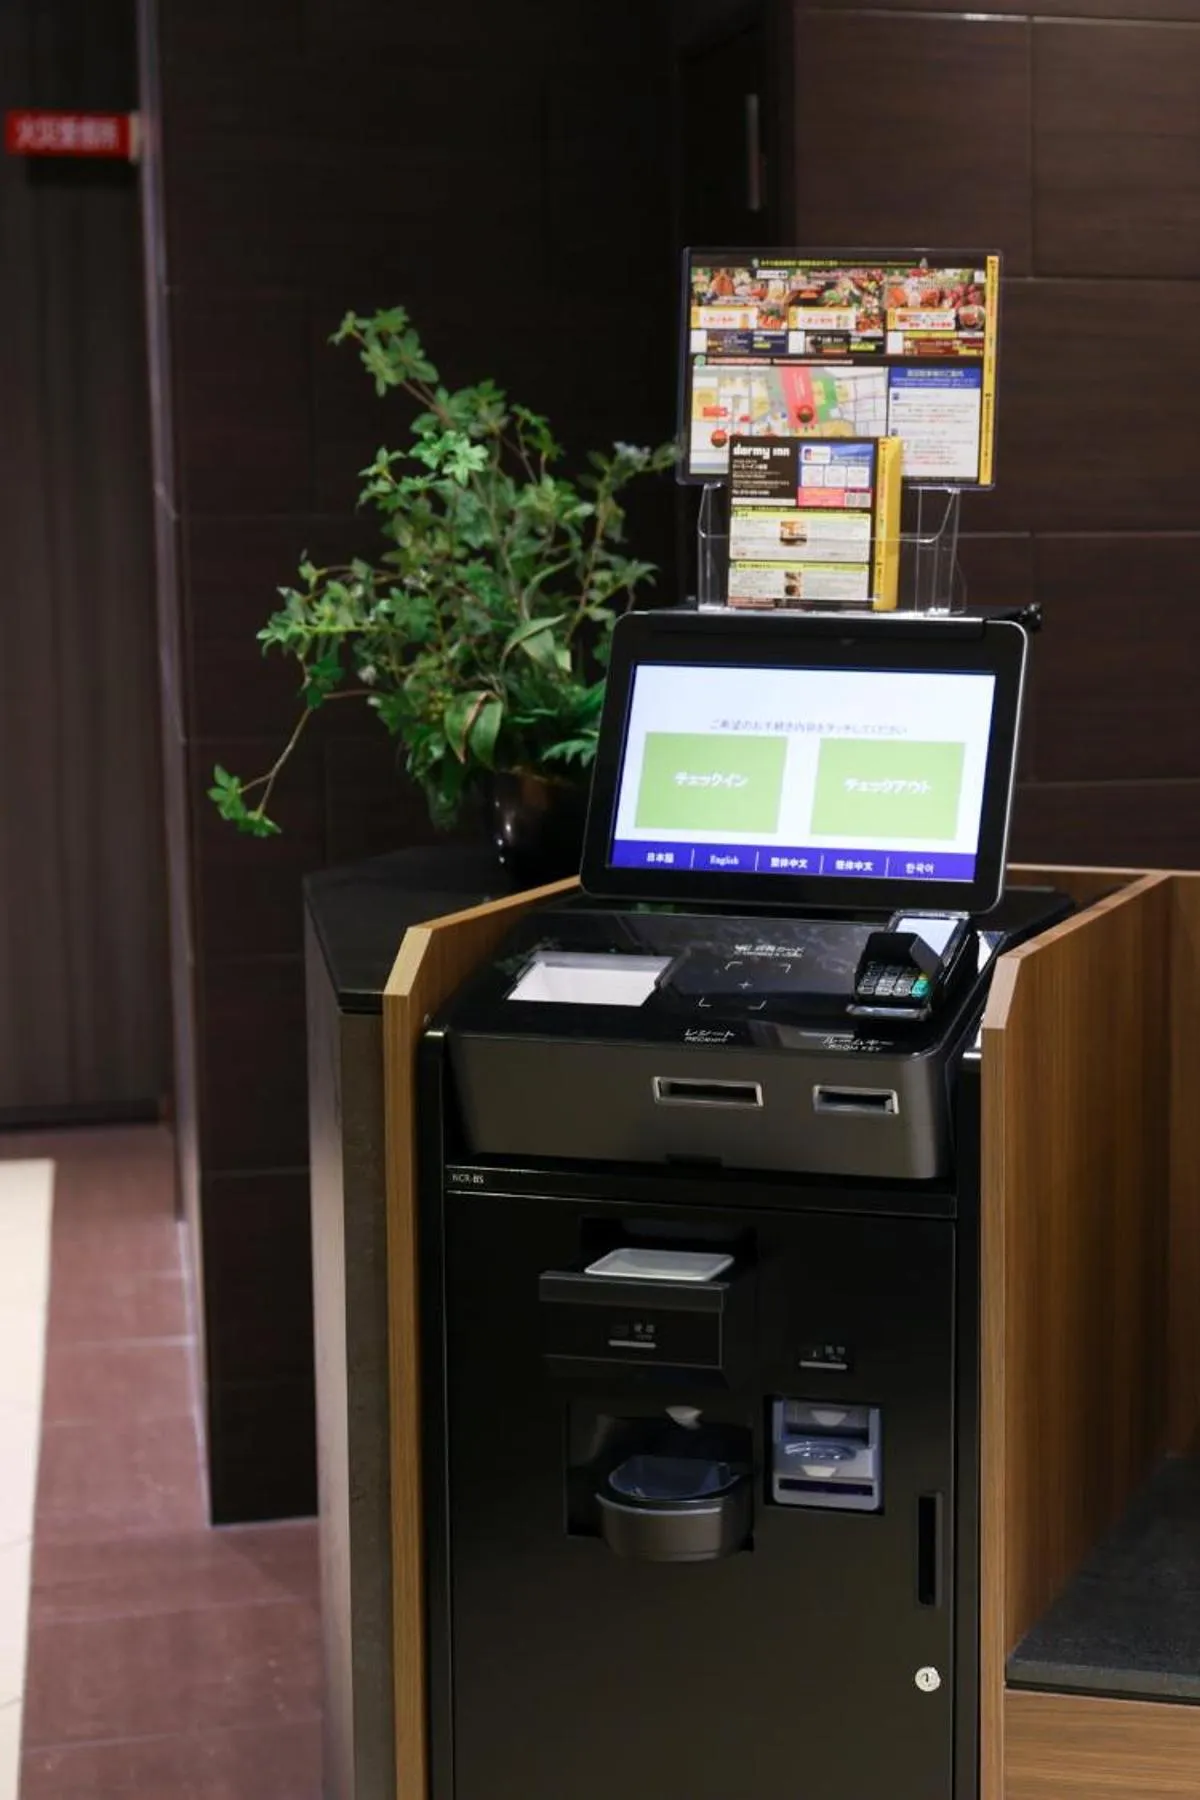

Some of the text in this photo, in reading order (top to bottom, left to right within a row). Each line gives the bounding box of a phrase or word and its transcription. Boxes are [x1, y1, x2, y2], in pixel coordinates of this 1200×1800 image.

[733, 444, 770, 459] dormy
[675, 771, 749, 788] チェックイン
[844, 778, 932, 796] チェックアウト
[646, 851, 675, 864] 日本語
[709, 854, 739, 866] English
[905, 862, 934, 875] 한국어
